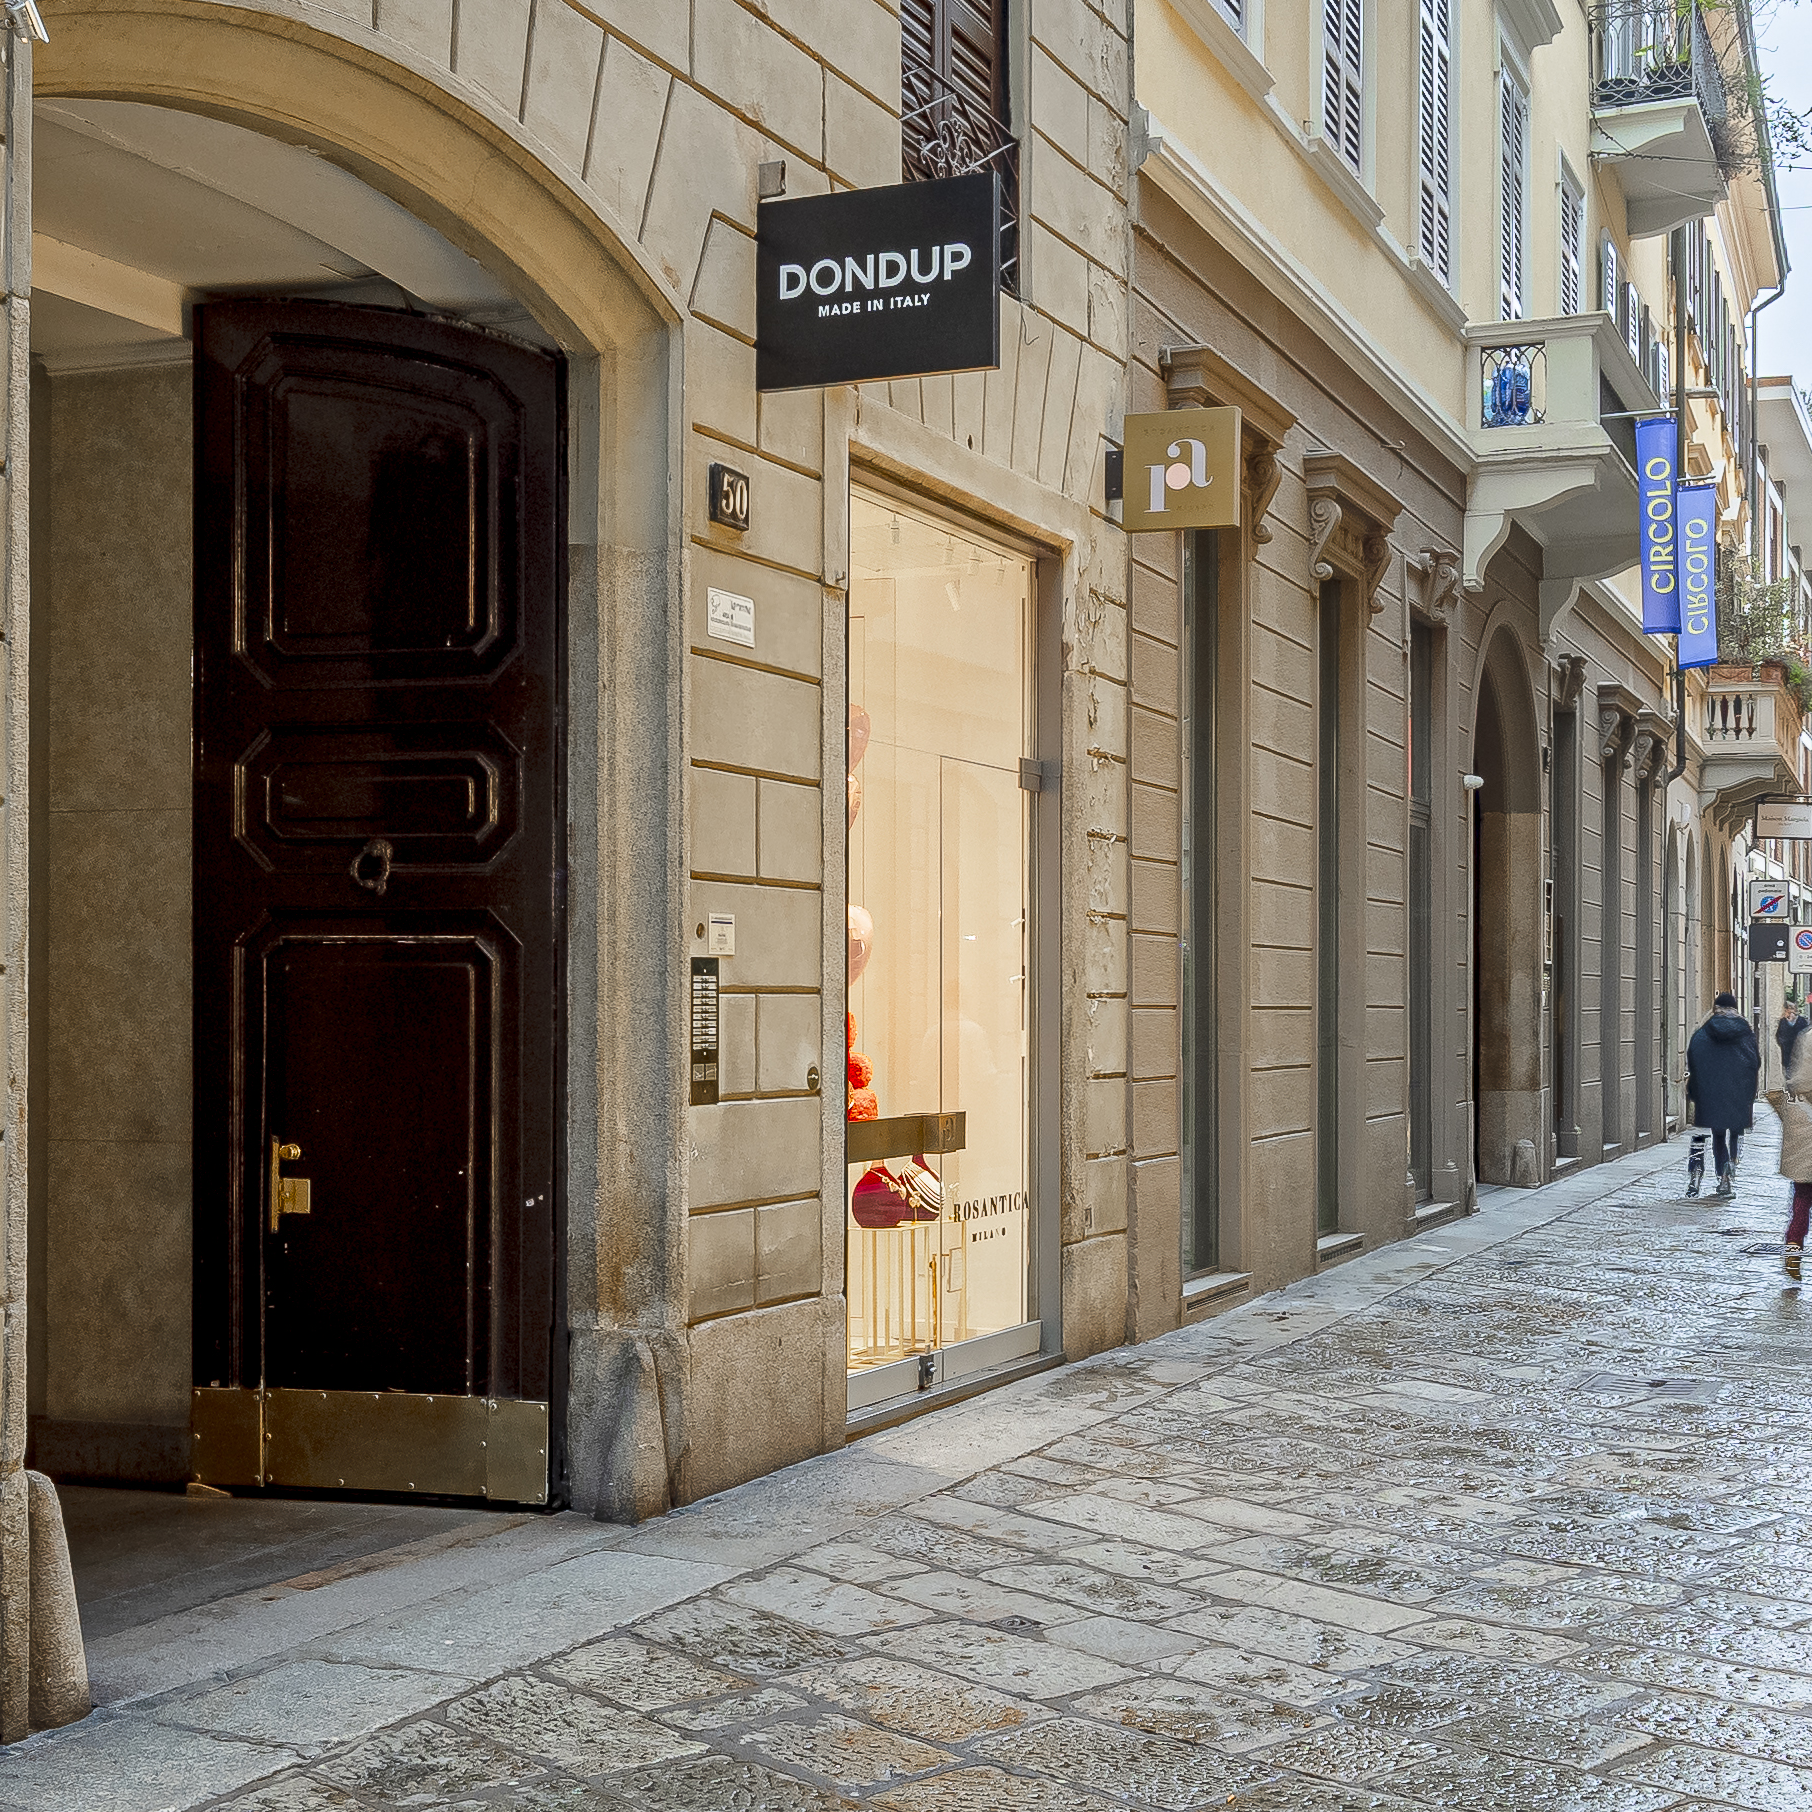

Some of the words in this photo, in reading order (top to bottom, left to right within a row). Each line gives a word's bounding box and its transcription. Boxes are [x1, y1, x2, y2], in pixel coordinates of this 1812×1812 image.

[778, 242, 972, 300] DONDUP
[818, 302, 861, 318] MADE
[867, 299, 884, 313] IN
[889, 292, 931, 310] ITALY
[721, 472, 748, 519] 50
[1645, 457, 1676, 594] CIRCOLO
[953, 1191, 1029, 1222] ROSANTICA
[971, 1227, 1006, 1242] MILANO
